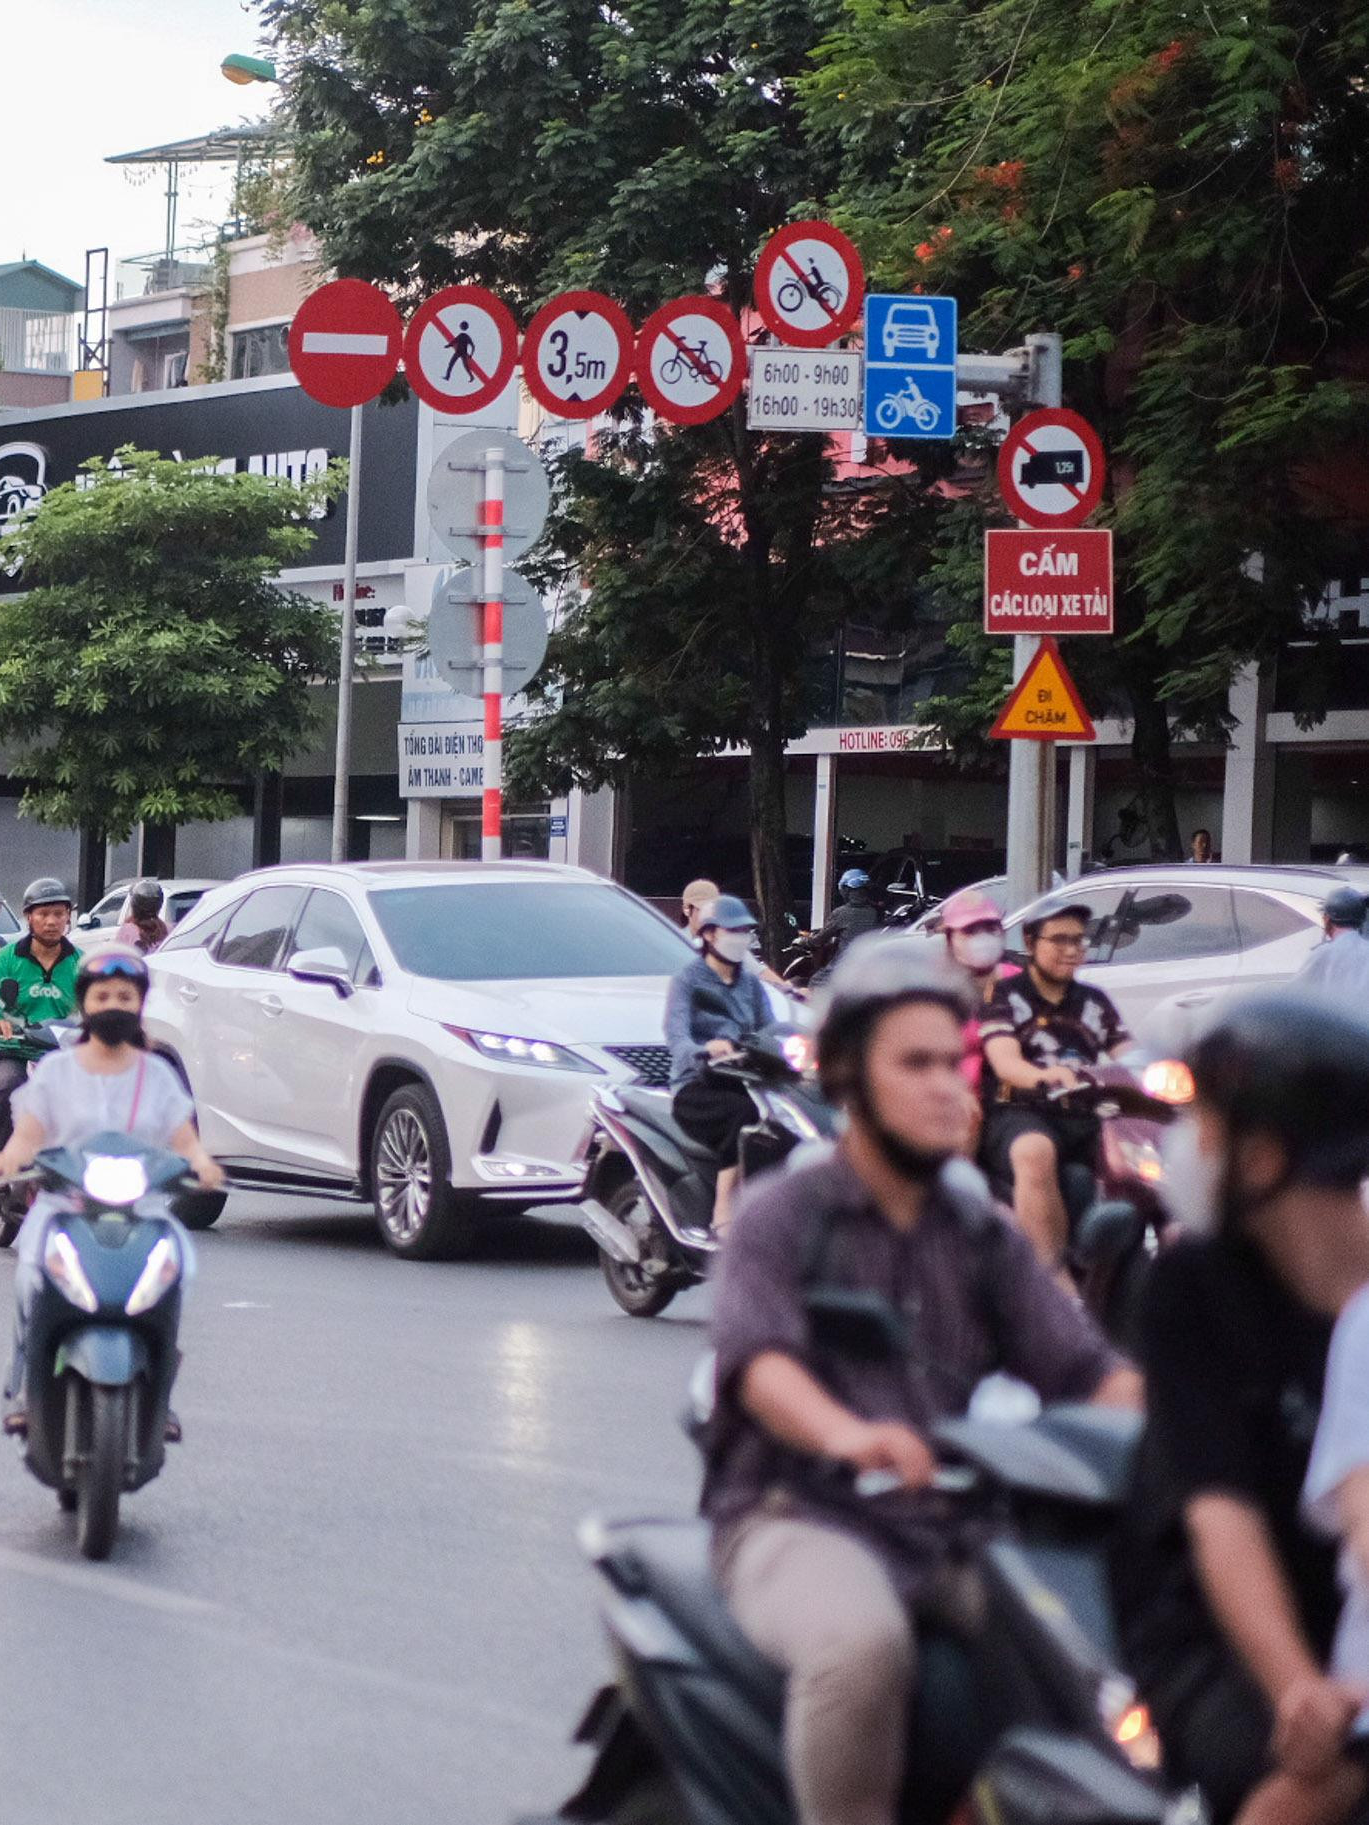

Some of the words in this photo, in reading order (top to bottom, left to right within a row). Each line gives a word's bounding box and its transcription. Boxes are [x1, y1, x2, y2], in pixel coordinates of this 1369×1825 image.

[764, 363, 800, 384] 6h00
[814, 364, 849, 385] 9h00
[754, 395, 798, 416] 16h00
[813, 397, 856, 418] 19h30
[1019, 543, 1078, 576] CẤM
[991, 590, 1022, 617] CÁC
[1023, 594, 1058, 620] LOẠI
[1061, 594, 1081, 616] XE
[1083, 587, 1107, 616] TẢI
[404, 729, 426, 755] TỔNG
[445, 732, 465, 758] ĐIỆN
[467, 735, 484, 754] THO
[839, 731, 887, 750] HOTLINE:
[424, 768, 451, 786] THANH
[459, 767, 484, 786] CAME
[29, 983, 62, 999] Grab
